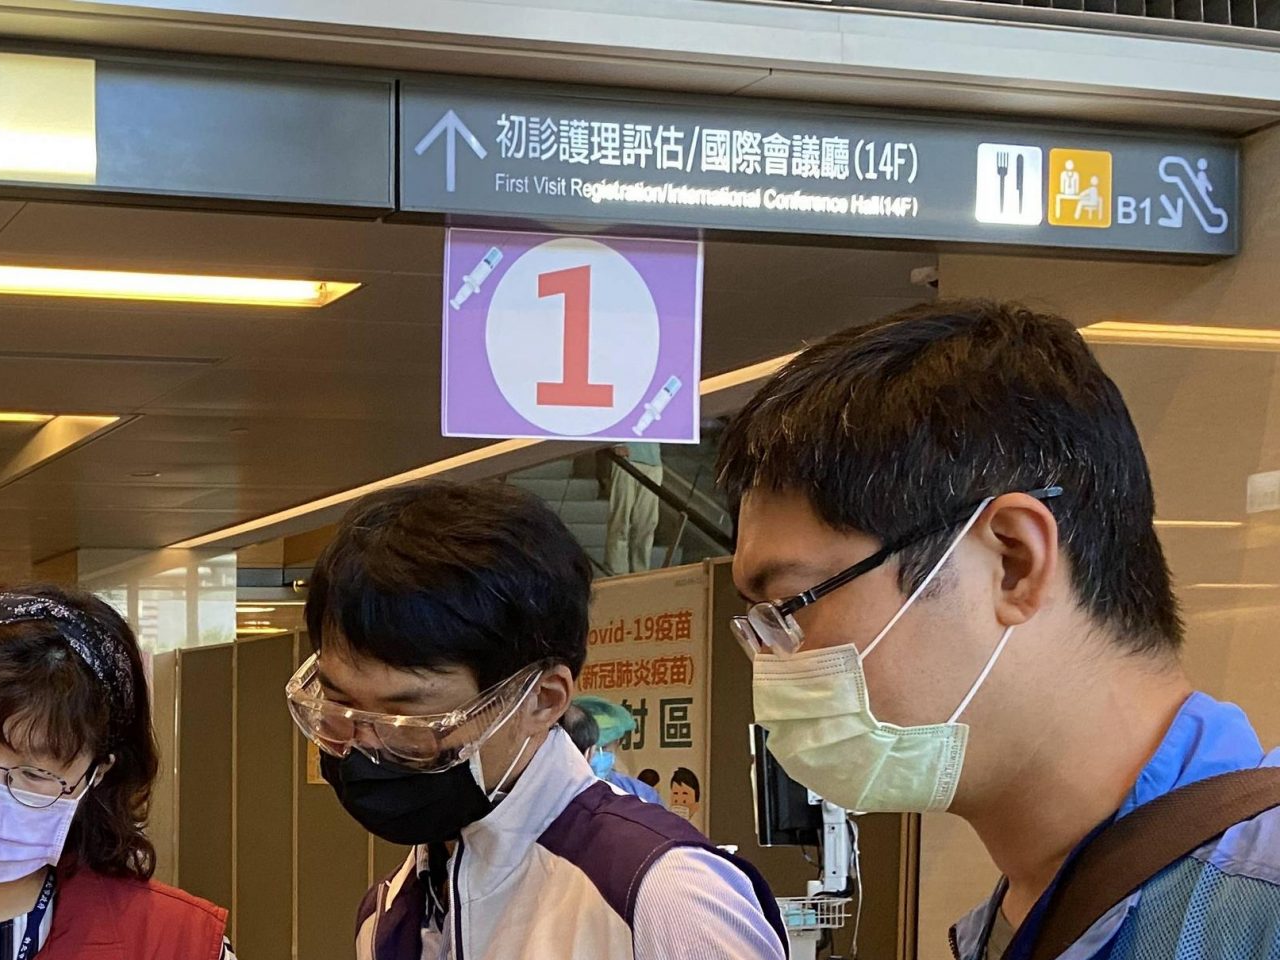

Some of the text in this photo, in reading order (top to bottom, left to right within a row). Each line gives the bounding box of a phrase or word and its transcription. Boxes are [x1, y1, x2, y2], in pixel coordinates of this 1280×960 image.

[495, 173, 529, 194] First
[533, 175, 566, 197] Visit
[764, 188, 849, 214] Conference
[1117, 196, 1152, 225] B1
[536, 265, 614, 409] 1
[588, 610, 693, 646] ovid-19疫苗
